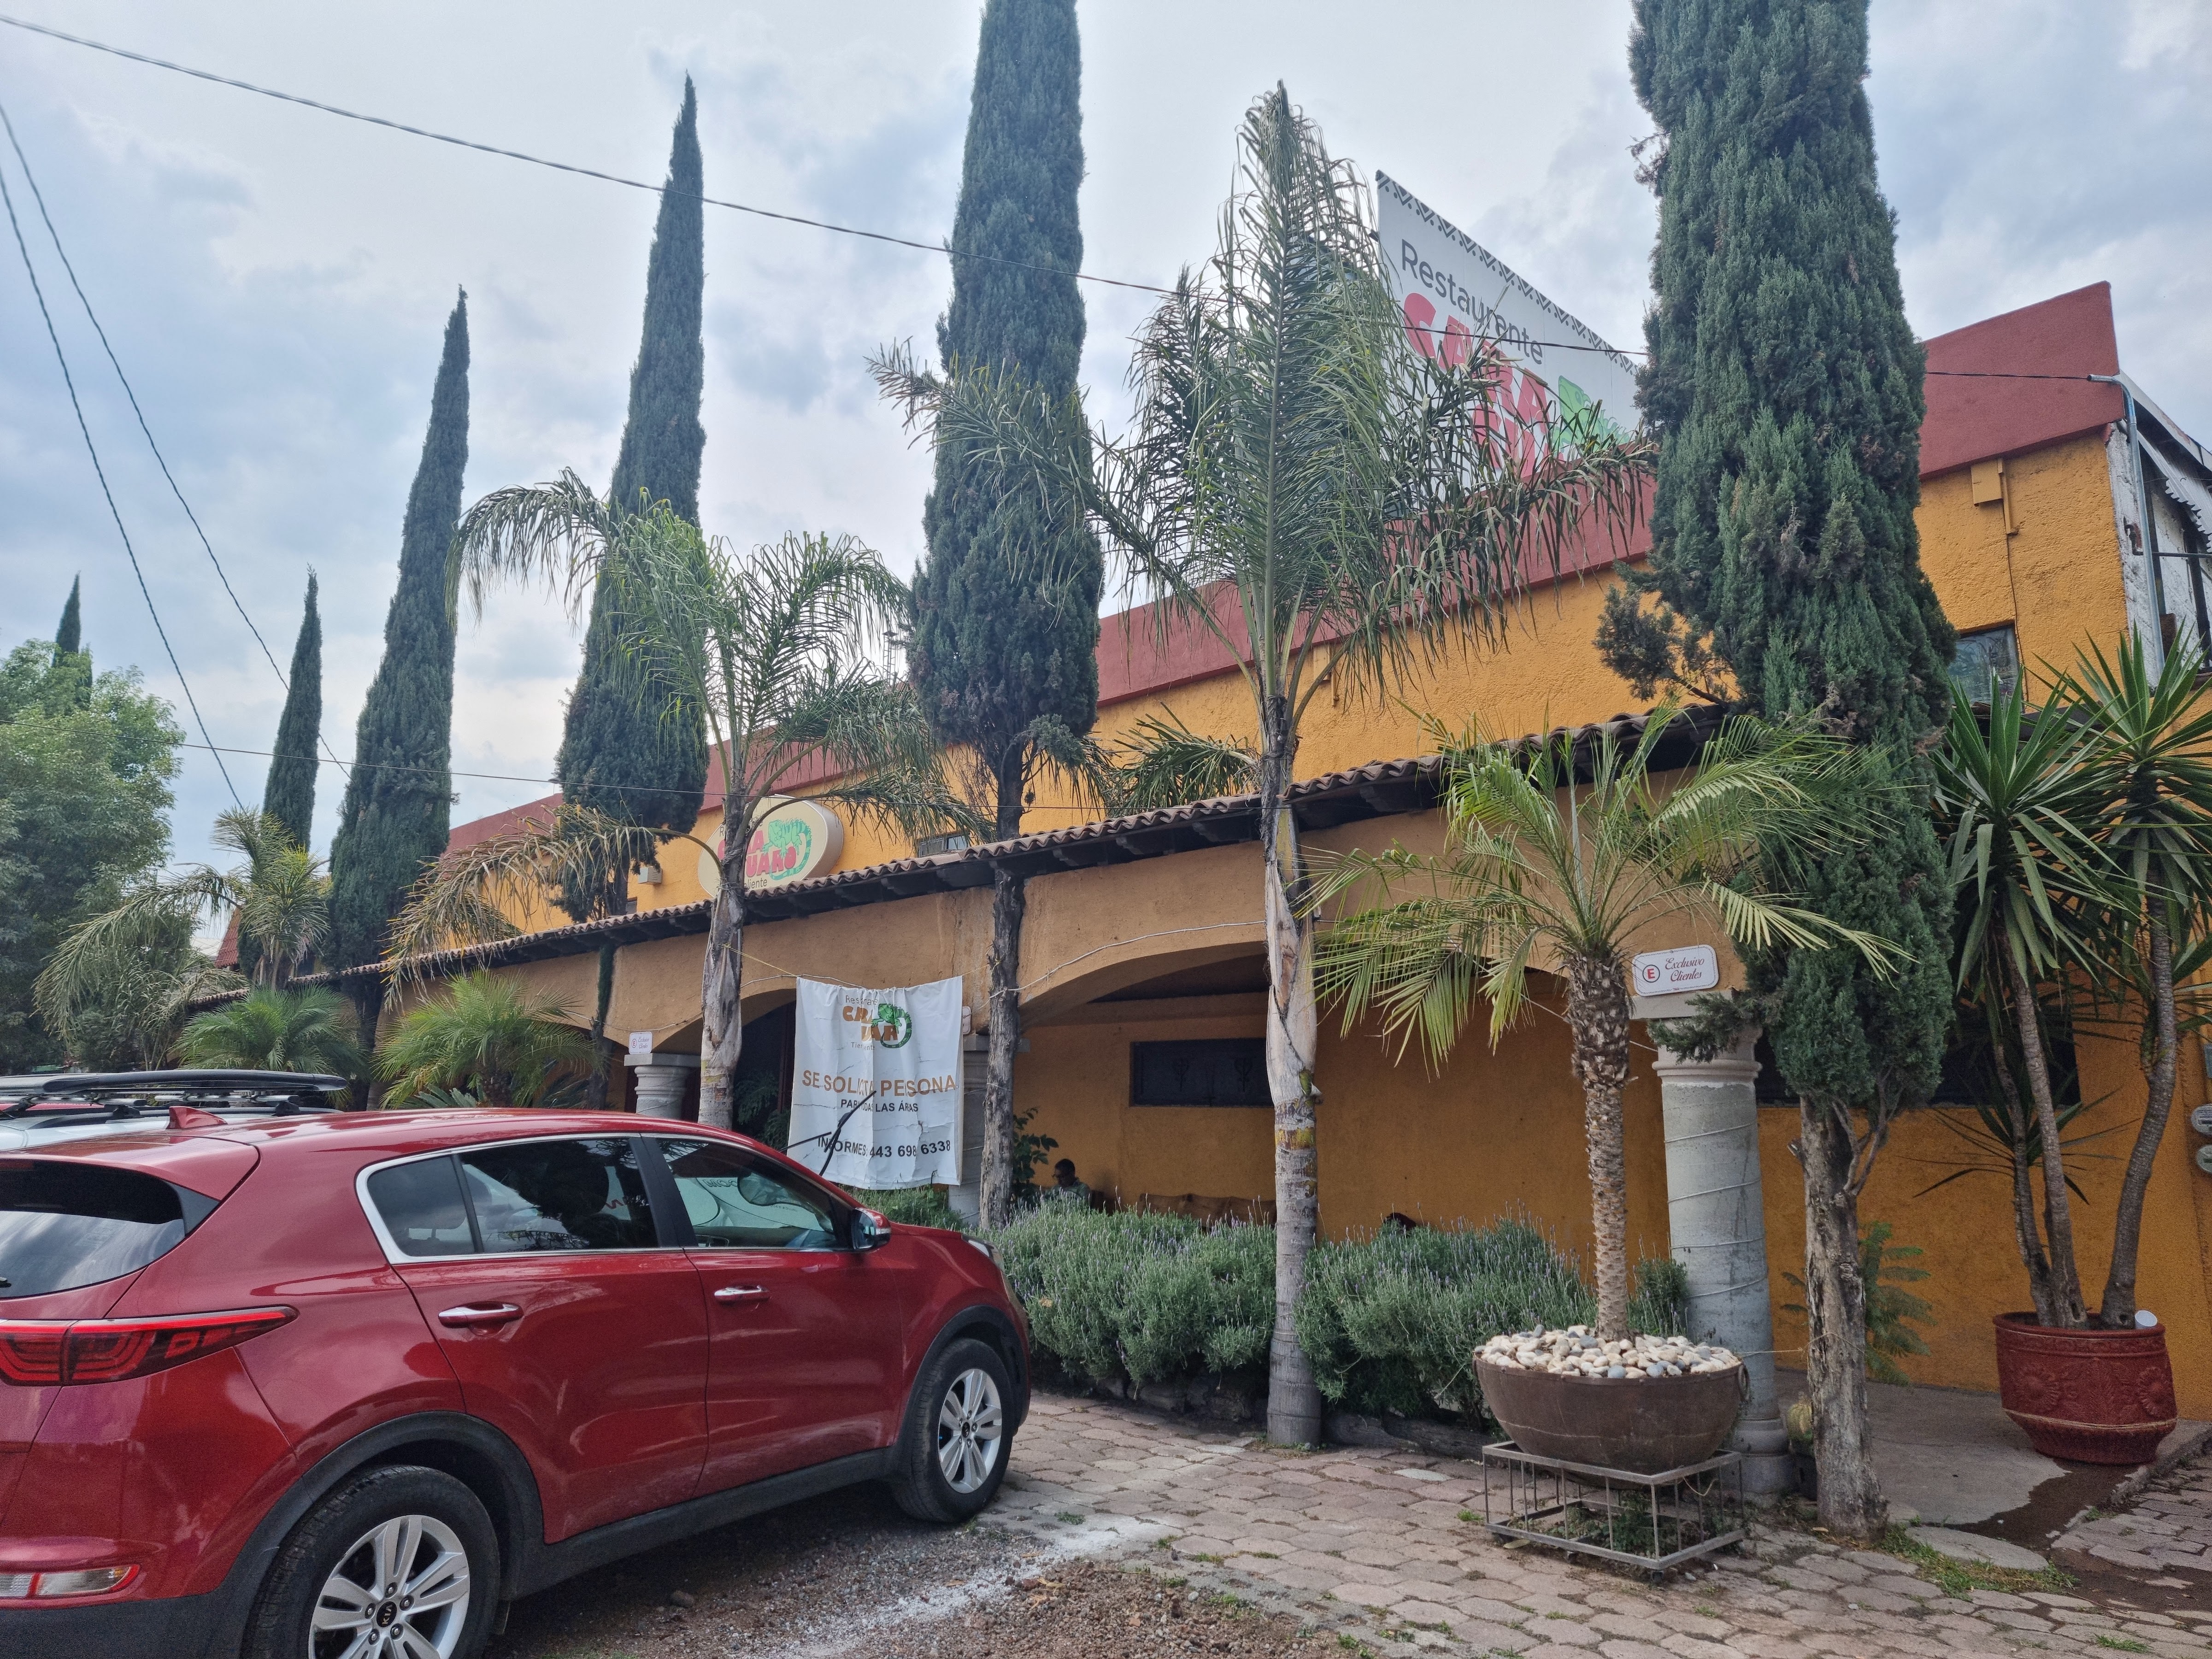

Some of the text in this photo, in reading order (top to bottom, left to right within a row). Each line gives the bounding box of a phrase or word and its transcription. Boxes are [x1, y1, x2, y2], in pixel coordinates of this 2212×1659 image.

[1402, 238, 1543, 365] Restaurante
[746, 846, 796, 877] UARO
[744, 877, 767, 889] aliente
[1665, 957, 1705, 970] Exclusivo
[1647, 968, 1655, 979] E
[1671, 968, 1702, 982] Clientes
[802, 1070, 820, 1088] SE
[876, 1103, 895, 1112] LAS
[870, 1146, 892, 1158] 443
[898, 1145, 917, 1157] 698
[920, 1140, 951, 1154] 6338
[382, 1605, 393, 1625] KIA
